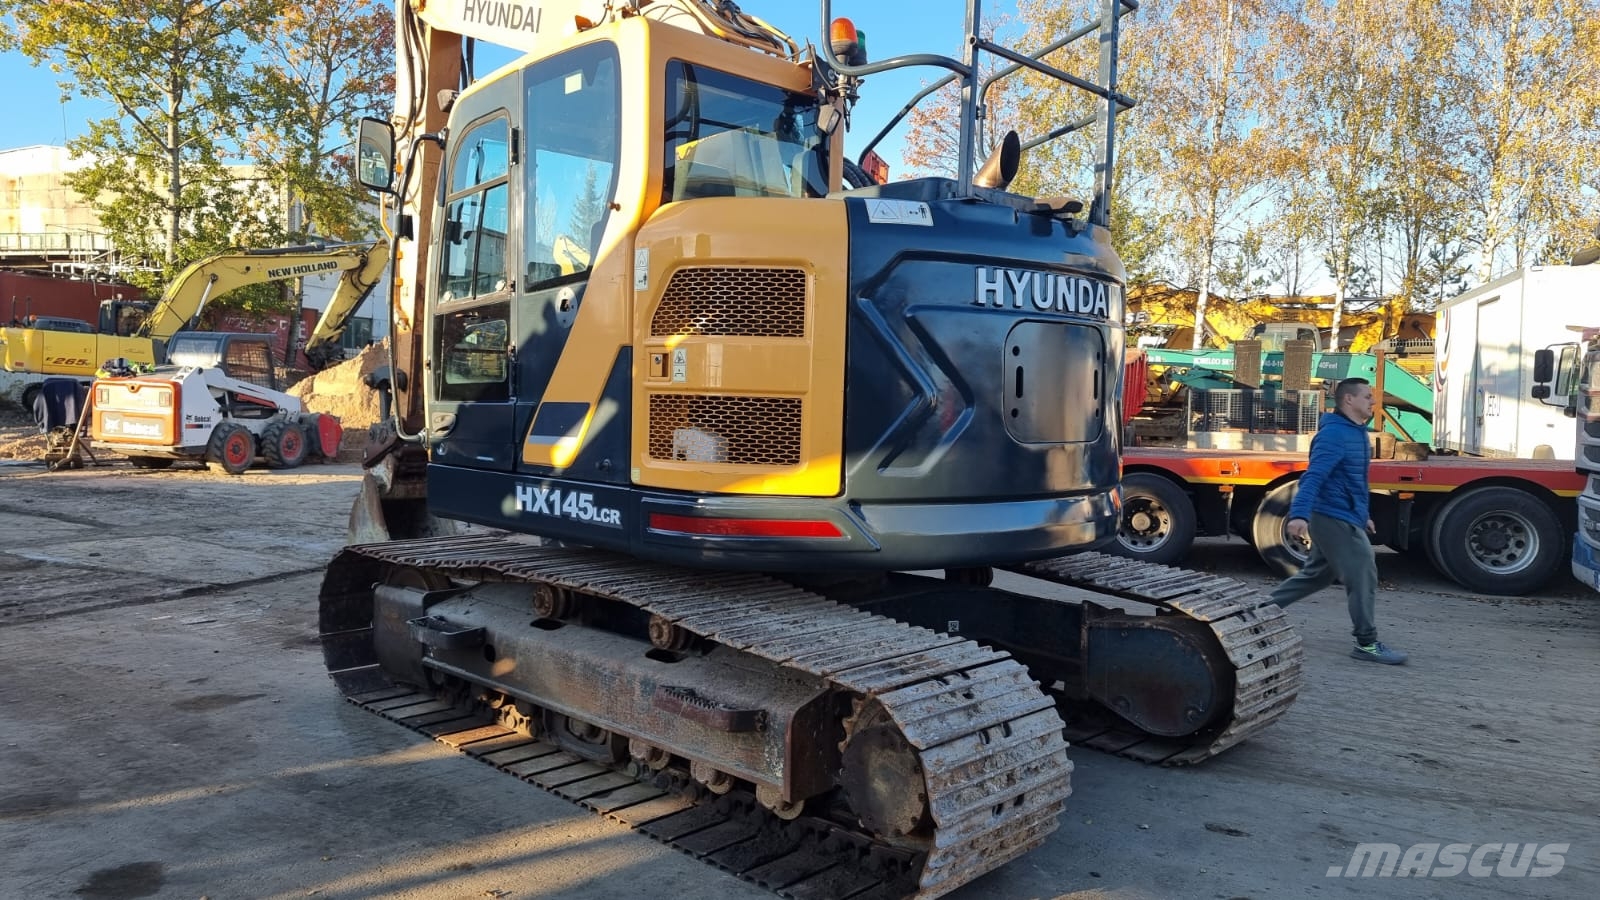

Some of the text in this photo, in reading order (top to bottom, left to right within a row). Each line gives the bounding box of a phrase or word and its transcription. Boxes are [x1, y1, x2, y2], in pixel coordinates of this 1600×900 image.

[463, 0, 542, 33] HYUNDAI
[267, 261, 338, 278] NEW HOLLAND
[122, 421, 160, 436] Bobcat
